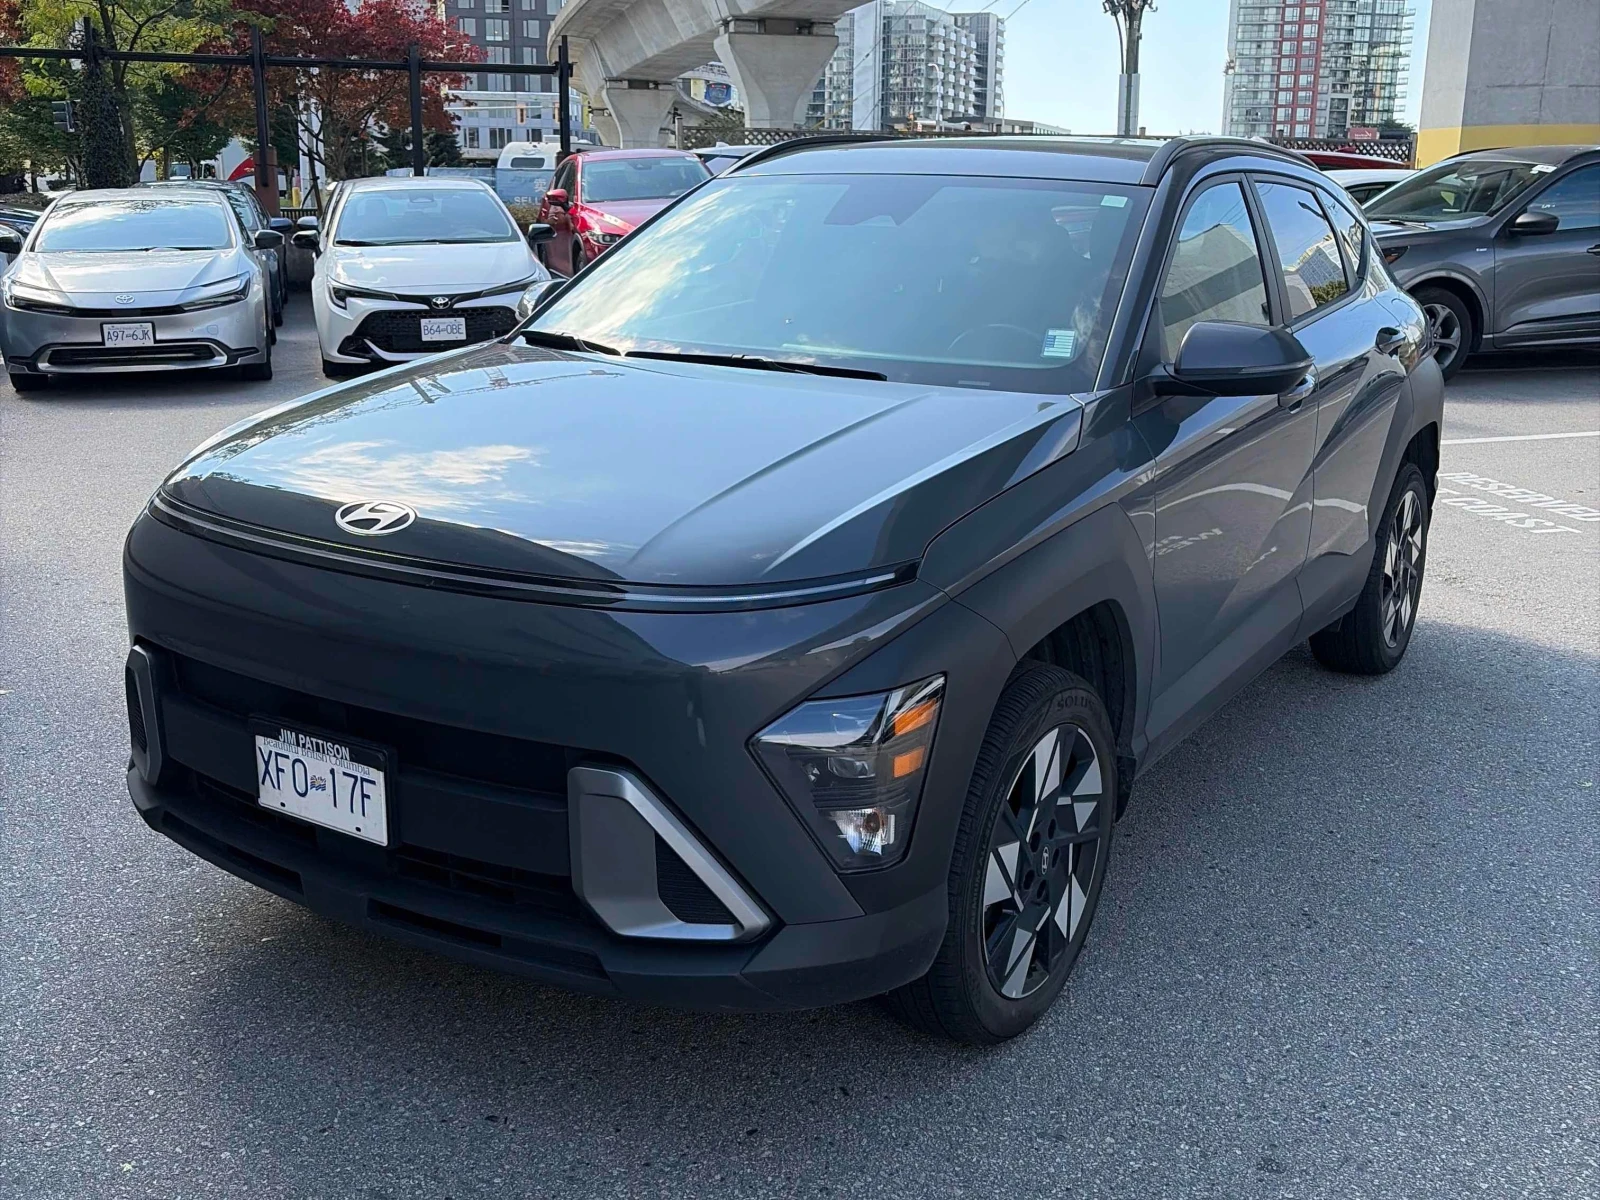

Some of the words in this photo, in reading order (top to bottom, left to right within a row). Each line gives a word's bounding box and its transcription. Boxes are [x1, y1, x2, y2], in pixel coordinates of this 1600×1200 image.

[131, 330, 151, 341] 6JK
[423, 324, 441, 336] B64
[1441, 497, 1582, 534] COAST
[263, 739, 299, 755] Beautiful
[301, 750, 328, 764] British
[329, 758, 370, 776] Columbia
[279, 728, 296, 744] JIM
[299, 734, 350, 761] PATTISON
[329, 767, 377, 817] 17F
